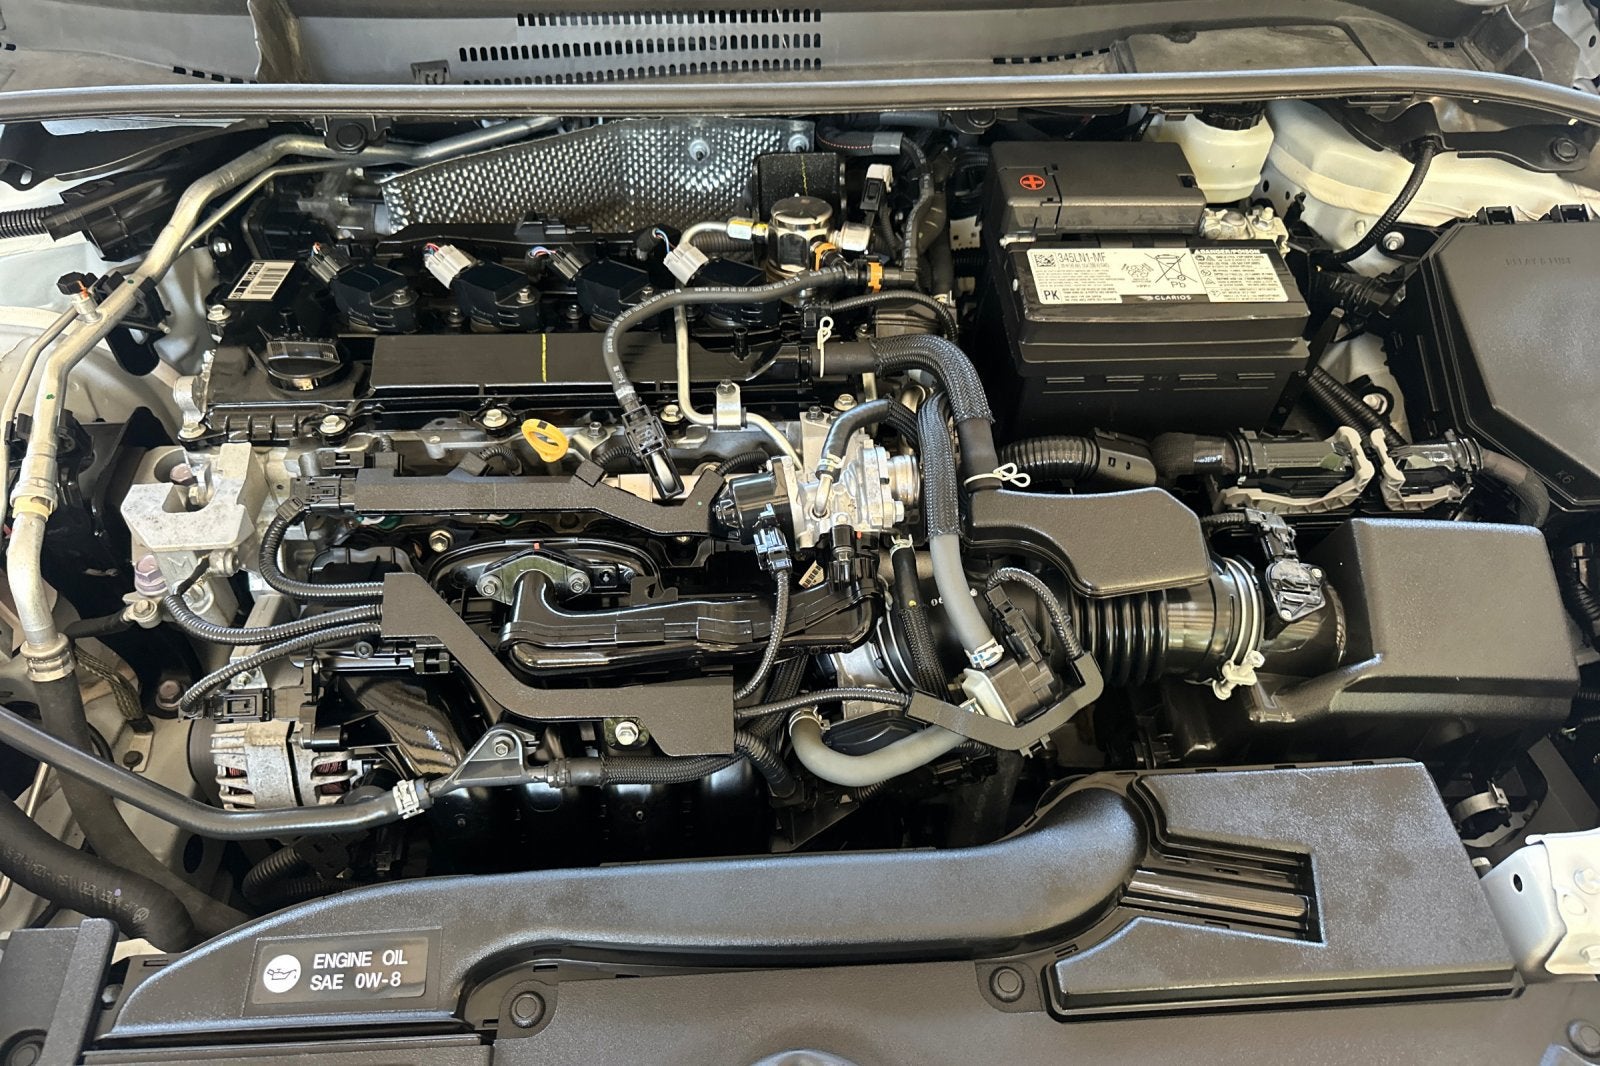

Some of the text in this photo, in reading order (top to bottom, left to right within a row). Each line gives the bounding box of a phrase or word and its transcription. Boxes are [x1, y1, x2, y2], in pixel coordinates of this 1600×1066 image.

[1057, 251, 1106, 263] 345LN1-MF
[1170, 280, 1187, 289] Pb
[1043, 290, 1061, 301] PK
[313, 949, 408, 970] ENGINE OIL
[309, 971, 402, 991] SAE 0W-8
